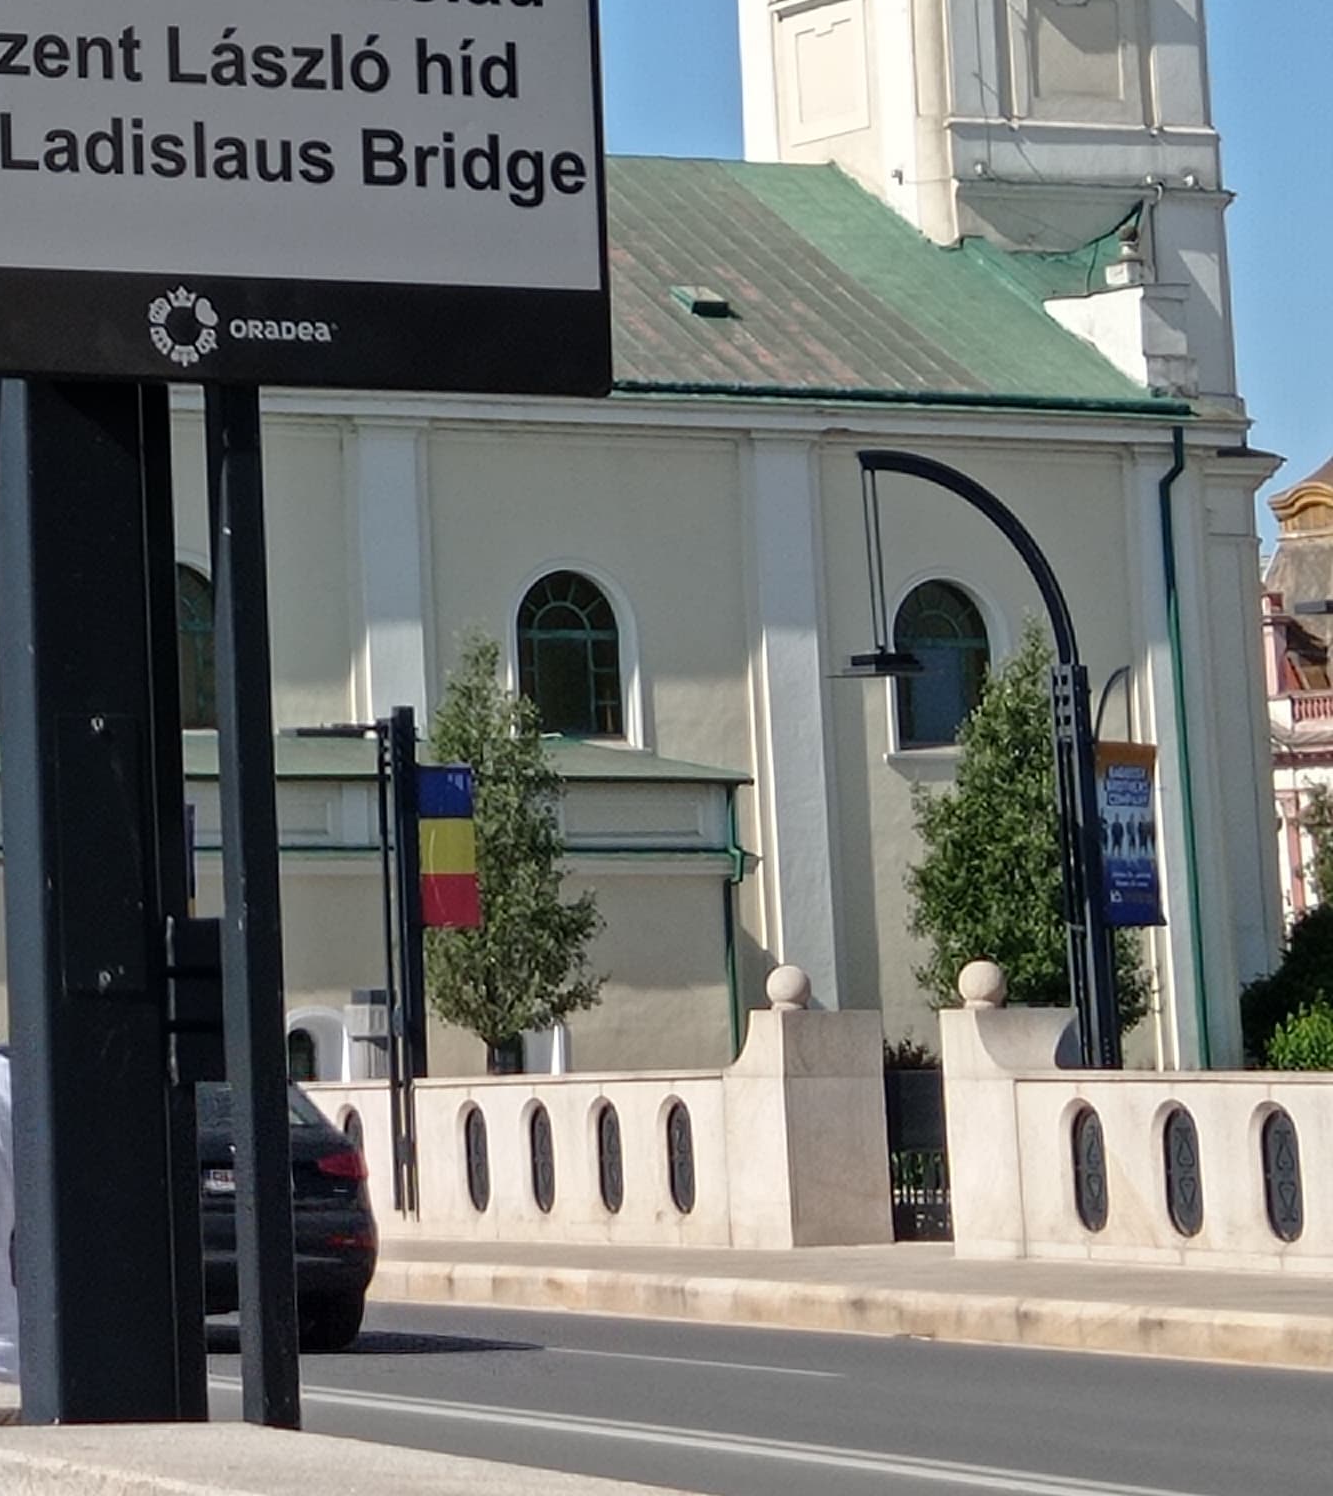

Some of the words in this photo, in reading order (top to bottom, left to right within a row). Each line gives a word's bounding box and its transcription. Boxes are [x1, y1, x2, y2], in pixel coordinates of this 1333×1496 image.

[166, 25, 391, 94] László
[414, 36, 520, 100] híd
[360, 127, 588, 208] Bridge
